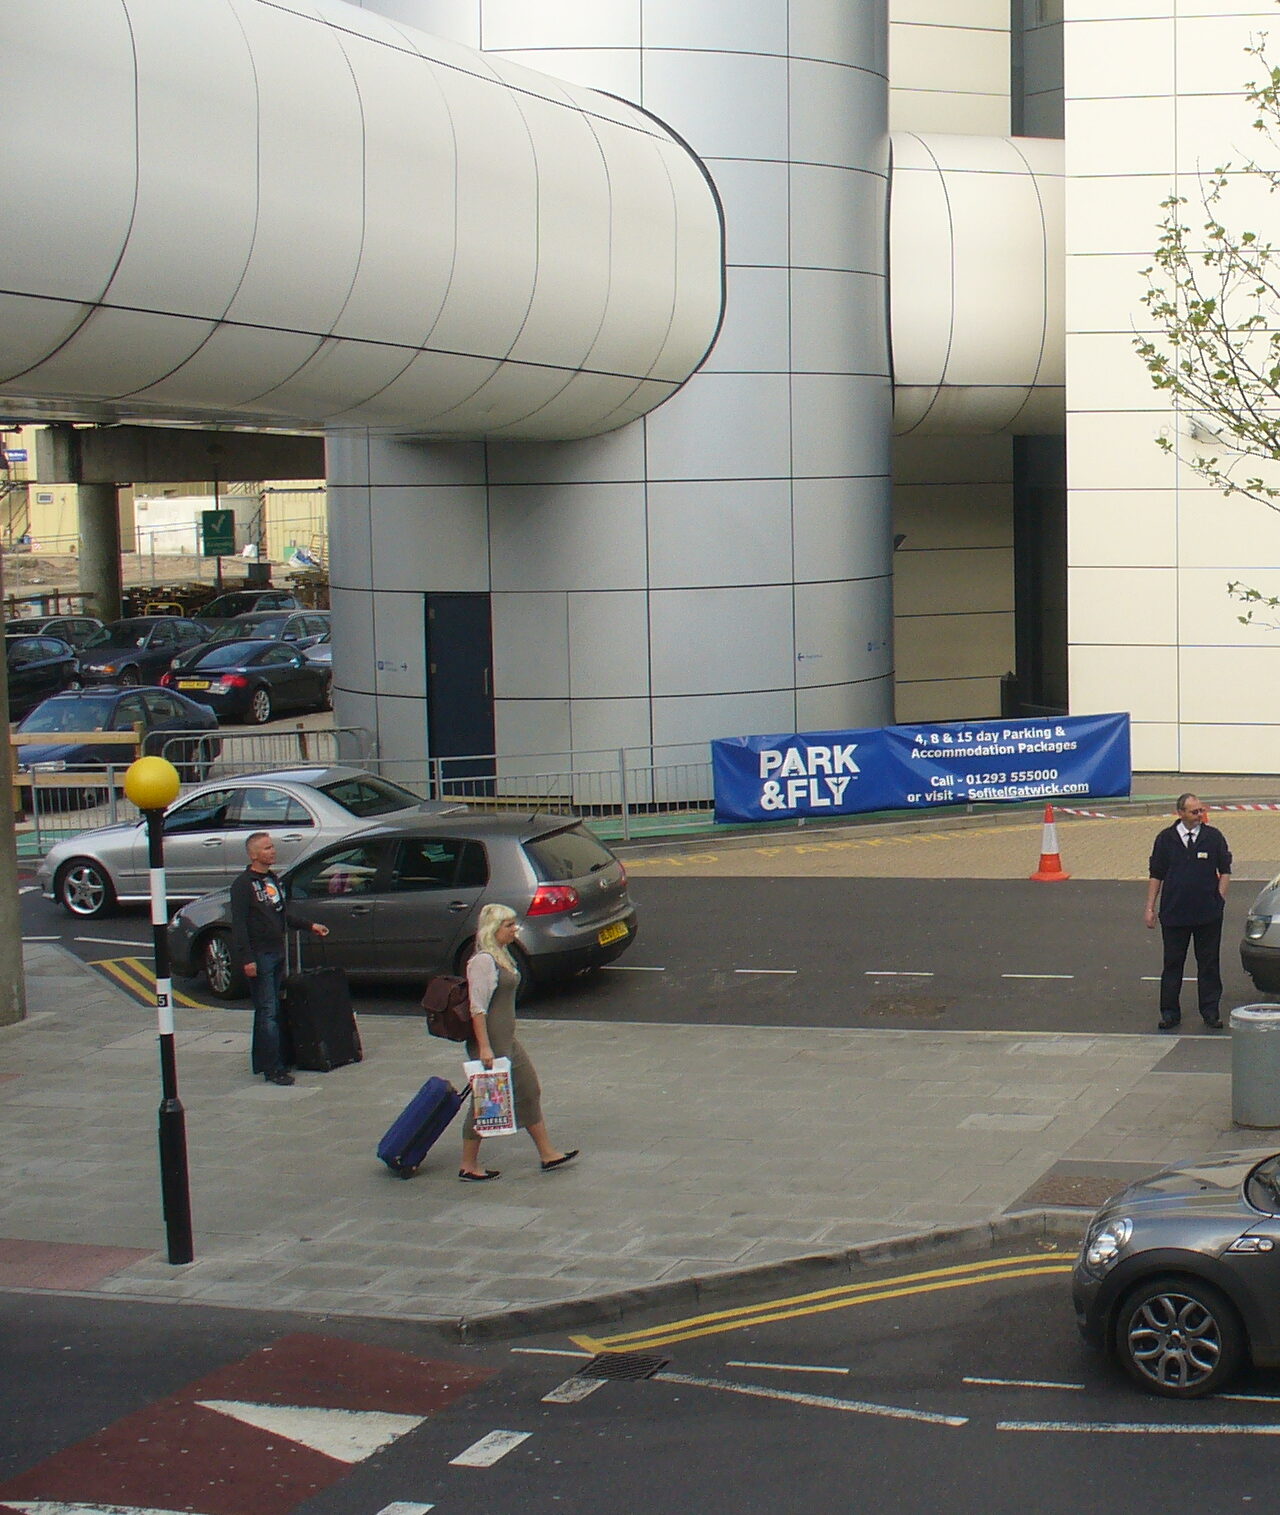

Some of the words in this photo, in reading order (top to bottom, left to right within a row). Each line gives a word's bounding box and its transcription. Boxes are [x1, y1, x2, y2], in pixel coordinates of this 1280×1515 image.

[915, 734, 926, 746] 4,
[930, 733, 939, 744] 8
[943, 733, 953, 744] &
[957, 731, 973, 743] 15
[976, 730, 999, 743] day
[1003, 727, 1051, 740] Parking
[1055, 725, 1066, 736] &
[911, 744, 1015, 759] Accommodation
[1018, 741, 1077, 753] Packages
[760, 744, 860, 778] PARK
[930, 774, 954, 787] Call
[966, 772, 1007, 785] 01293
[1010, 769, 1058, 782] 555000
[907, 793, 922, 802] or
[925, 789, 953, 801] visit
